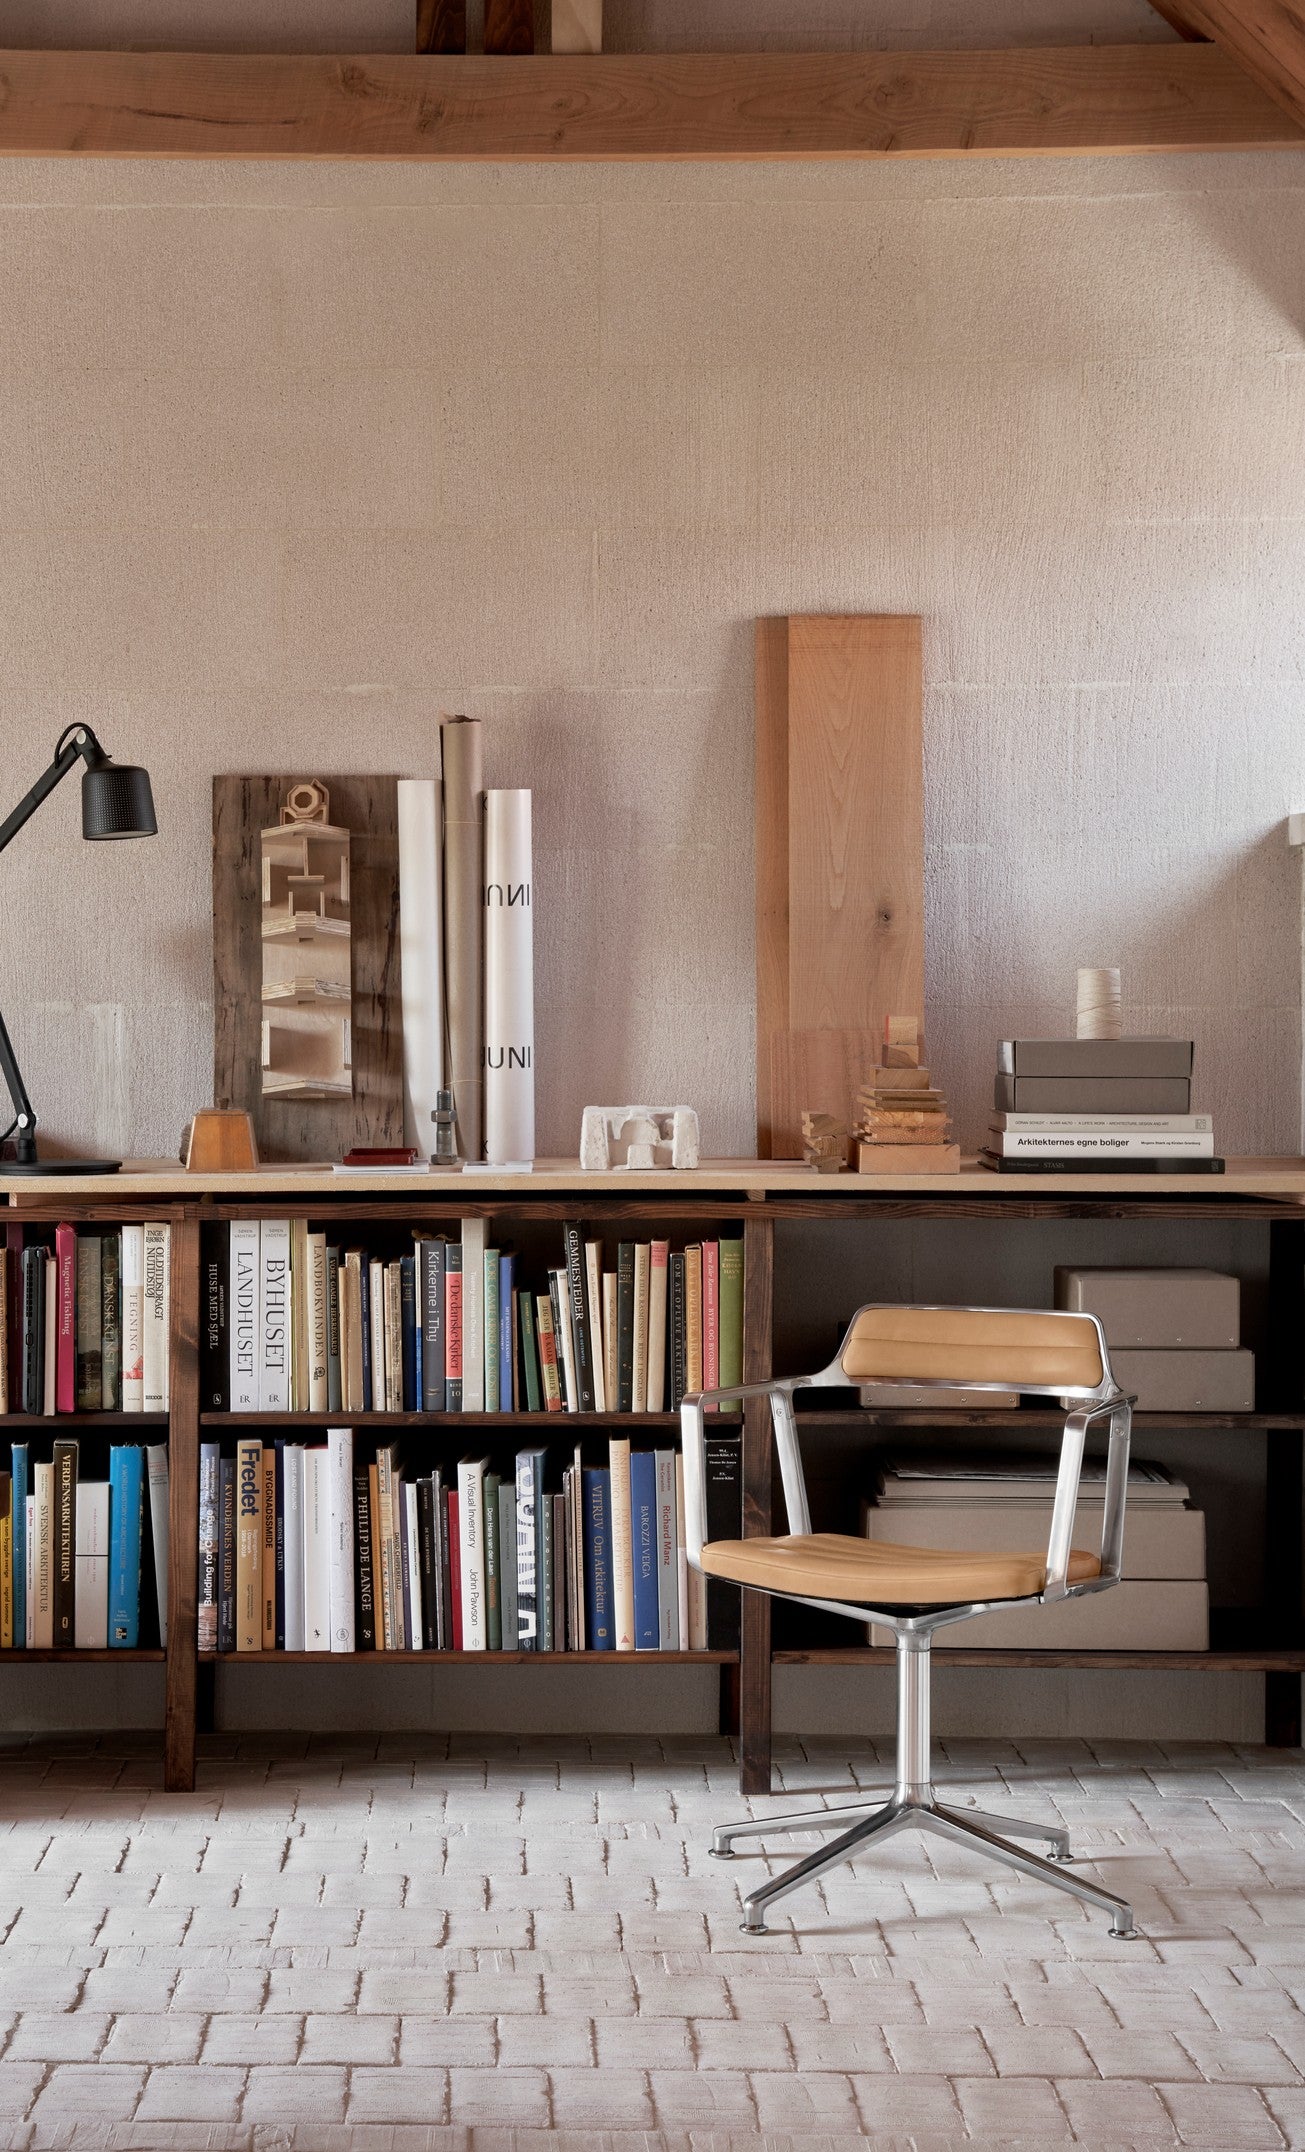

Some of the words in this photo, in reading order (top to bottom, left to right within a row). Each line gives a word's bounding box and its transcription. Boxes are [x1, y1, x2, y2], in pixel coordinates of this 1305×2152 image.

[1018, 1138, 1075, 1146] Arkitekternes
[1076, 1139, 1097, 1148] egne
[1099, 1138, 1130, 1149] boliger
[62, 1256, 72, 1298] Magnetic
[79, 1247, 89, 1291] DANSK
[145, 1247, 156, 1299] NUTIDSTØJ
[208, 1263, 218, 1293] HUSE
[329, 1259, 337, 1279] VORE
[487, 1258, 497, 1281] VORE
[569, 1230, 584, 1320] GEMMESTEDER
[675, 1263, 681, 1278] OM
[688, 1252, 697, 1269] OM
[155, 1247, 164, 1320] OLDTIDSDRAGT
[330, 1281, 338, 1305] GAMLE
[428, 1251, 440, 1306] Kirkerne
[450, 1280, 461, 1299] De
[468, 1271, 477, 1295] Twenty
[675, 1282, 681, 1293] AT
[688, 1272, 697, 1286] AT
[79, 1292, 89, 1336] KUNST
[104, 1276, 115, 1320] DANSK
[208, 1295, 218, 1320] MED
[237, 1251, 254, 1377] LANDHUSET
[314, 1245, 324, 1358] LANDBOKVINDEN
[487, 1284, 497, 1315] GAMLE
[542, 1305, 550, 1317] JEG
[689, 1290, 698, 1332] OPLEVE
[62, 1301, 72, 1336] Fishing
[130, 1292, 138, 1352] TEGNING
[265, 1258, 286, 1374] BYHUSET
[426, 1317, 440, 1342] Thy
[450, 1300, 461, 1337] danske
[487, 1317, 497, 1344] KIRKER
[104, 1323, 115, 1365] KUNST
[207, 1323, 219, 1350] SJÆL
[708, 1329, 715, 1341] OG
[450, 1337, 461, 1371] Kirker
[487, 1346, 497, 1364] OG
[545, 1341, 556, 1391] KALKMALERIER
[487, 1366, 497, 1401] KLOSTRE
[241, 1448, 260, 1516] Fredet
[611, 1450, 621, 1499] PALLADIO
[619, 1451, 629, 1492] ANDREA
[265, 1470, 273, 1549] BYGGNADSSMIDE
[467, 1481, 476, 1506] Visual
[592, 1485, 604, 1530] VITRUV
[40, 1505, 49, 1545] SVENSK
[61, 1454, 71, 1582] VERDENSARKITEKTUREN
[121, 1518, 127, 1526] OF
[203, 1509, 215, 1548] Change
[223, 1484, 232, 1549] KVINDERNES
[358, 1496, 370, 1543] PHILIP
[466, 1508, 477, 1549] Inventory
[613, 1508, 622, 1527] OM
[621, 1508, 630, 1533] FYRA
[640, 1505, 650, 1546] BAROZZI
[663, 1505, 672, 1540] Richard
[3, 1537, 11, 1558] byggde
[203, 1550, 214, 1565] for
[360, 1546, 370, 1563] DE
[593, 1535, 603, 1556] Om
[641, 1548, 651, 1578] VEIGA
[663, 1541, 672, 1566] Manz
[40, 1547, 49, 1612] ARKITEKTUR
[203, 1566, 214, 1607] Building
[224, 1551, 232, 1592] VERDEN
[360, 1567, 372, 1611] LANGE
[469, 1568, 478, 1590] John
[594, 1558, 606, 1614] Arkitektur
[3, 1586, 11, 1602] ingrid
[470, 1592, 479, 1626] Pawson
